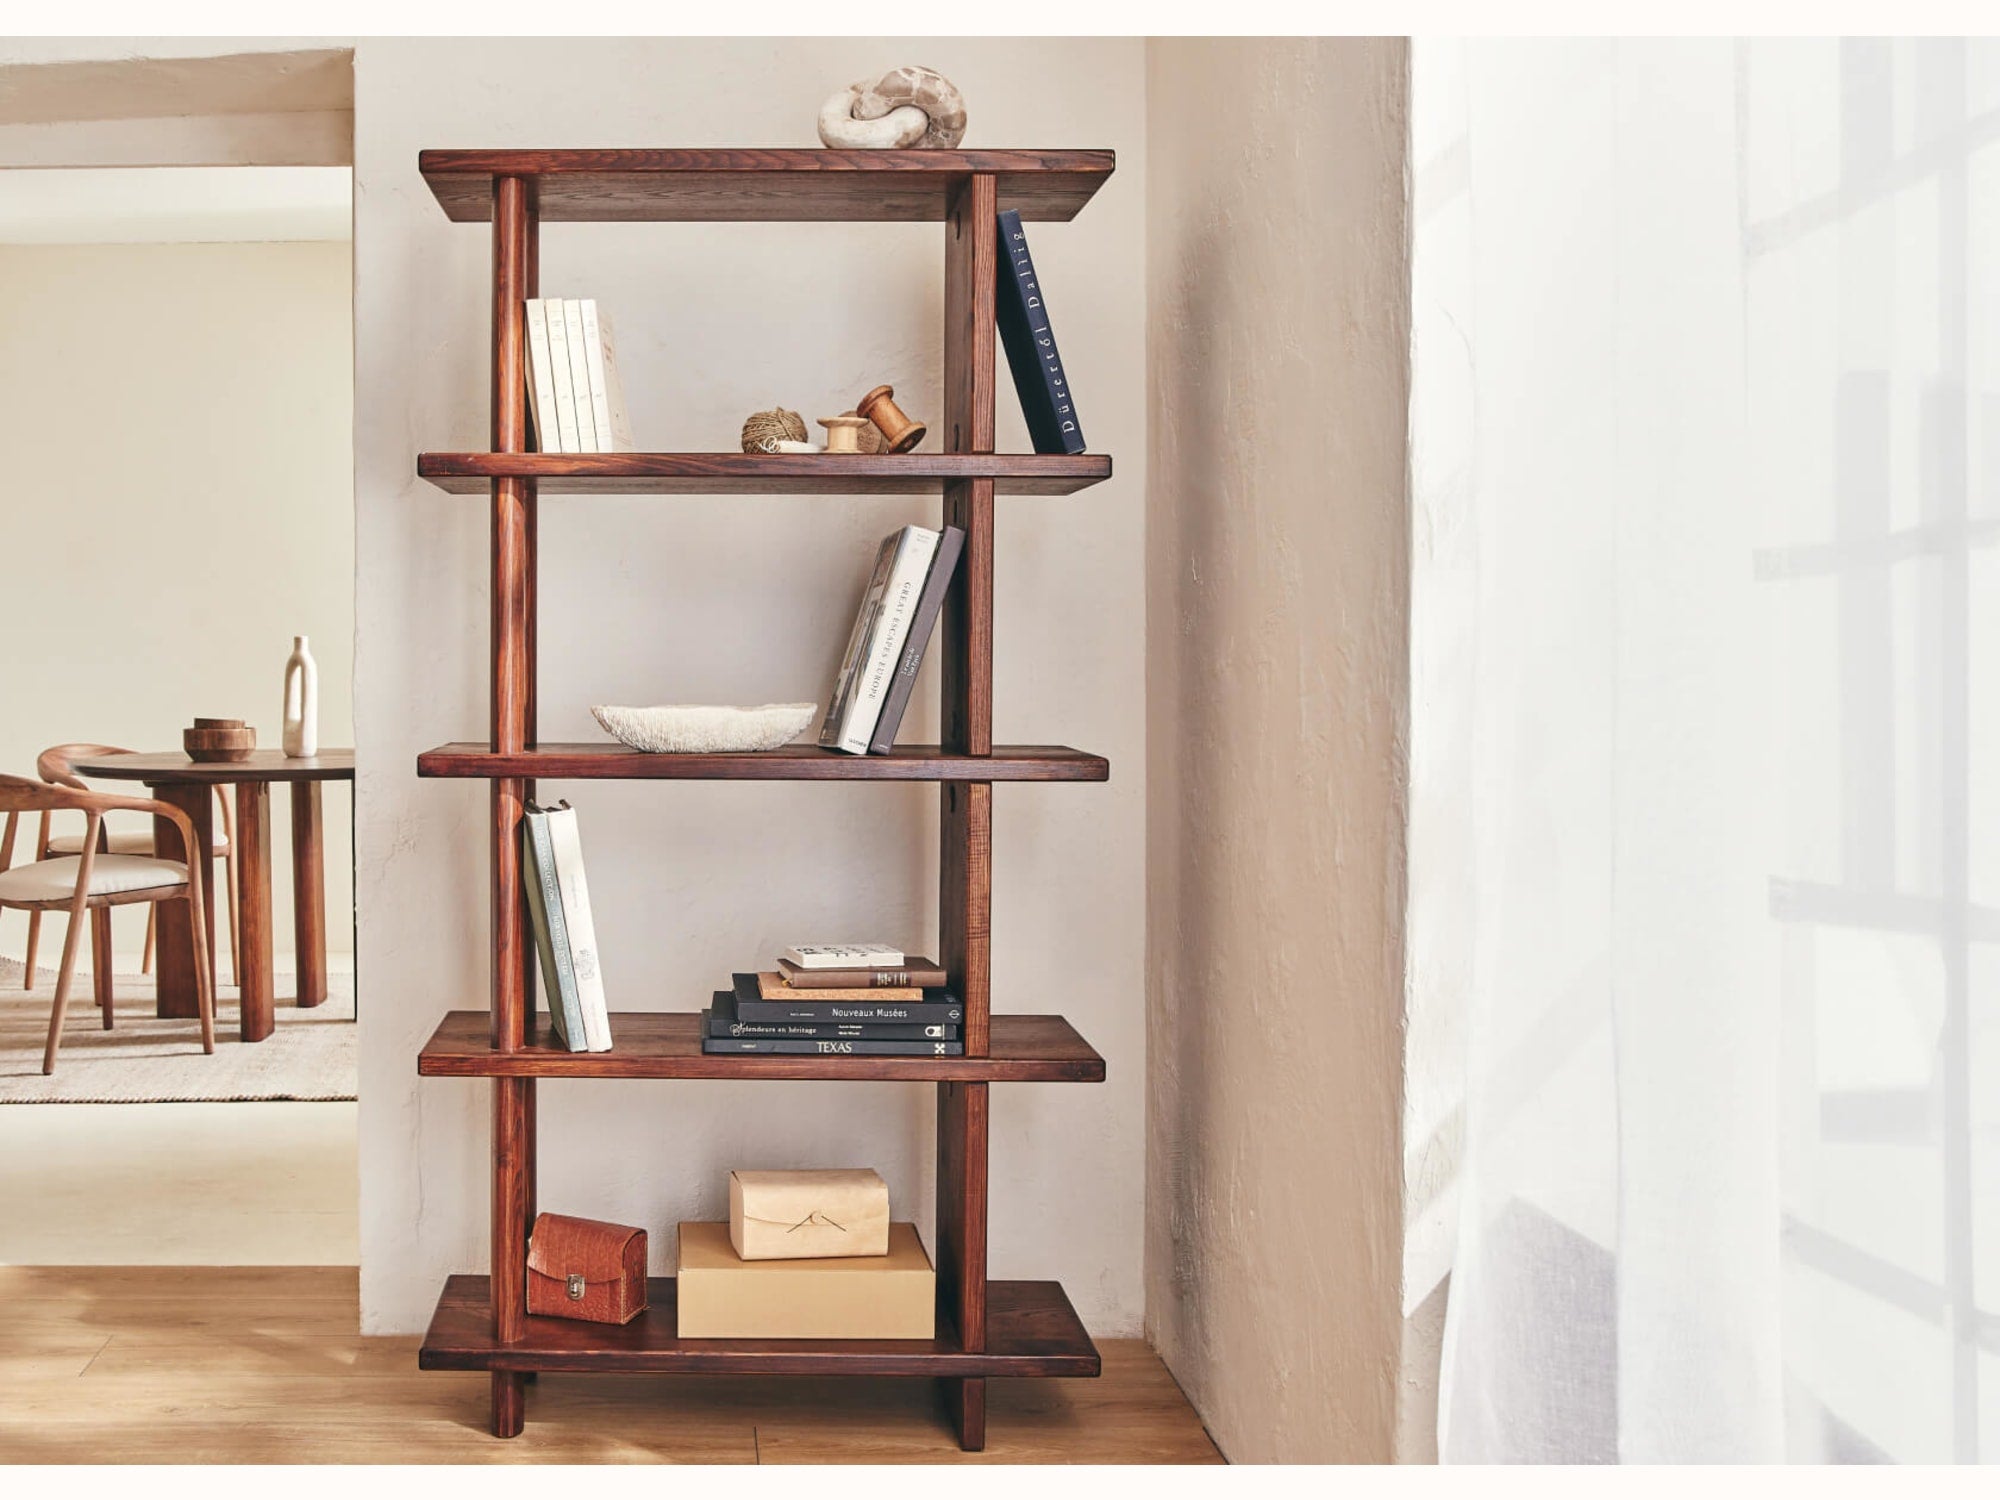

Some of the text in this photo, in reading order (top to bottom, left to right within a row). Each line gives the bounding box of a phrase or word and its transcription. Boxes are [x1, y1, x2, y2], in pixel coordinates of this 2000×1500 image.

[868, 582, 912, 700] GREAT ESCAPES EUROPE
[832, 1007, 908, 1018] Nouveaux Musées
[788, 1025, 817, 1036] héritage
[816, 1041, 852, 1053] TEXAS
